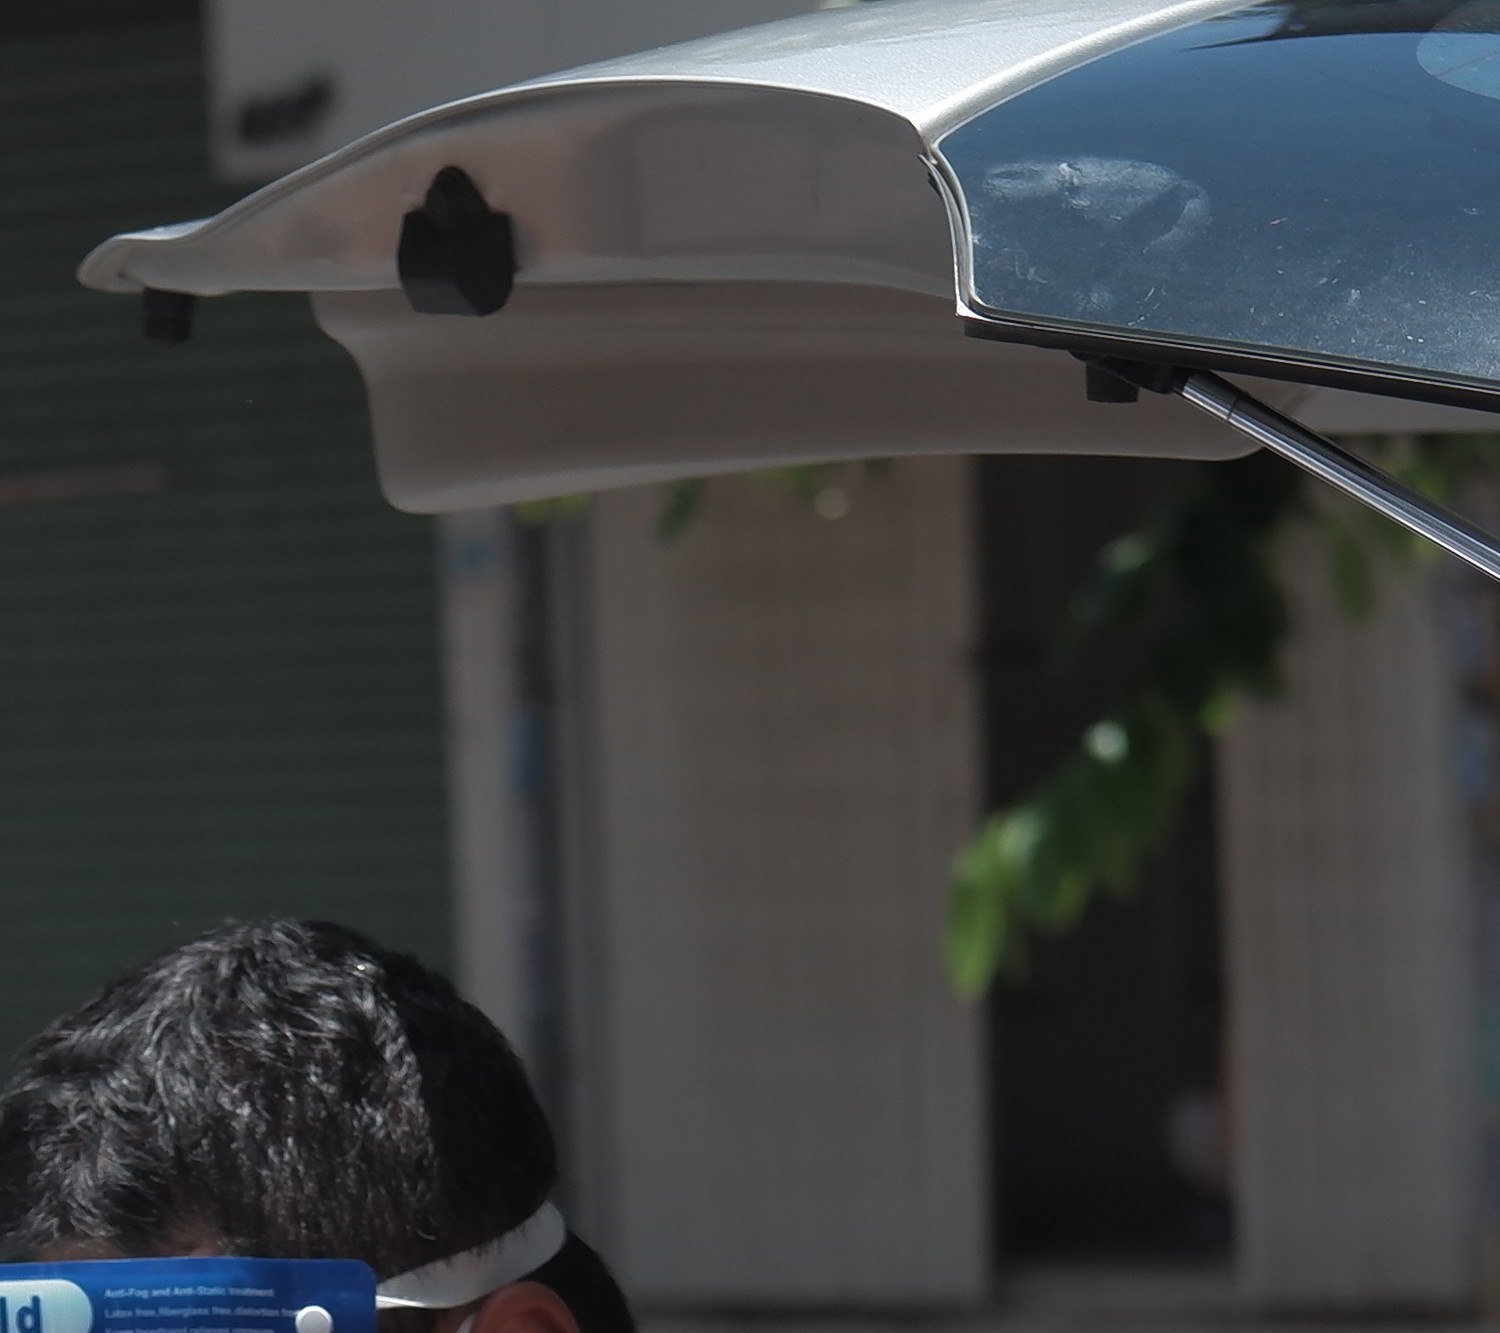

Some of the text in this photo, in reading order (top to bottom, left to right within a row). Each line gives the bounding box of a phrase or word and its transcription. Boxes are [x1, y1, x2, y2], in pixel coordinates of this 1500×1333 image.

[104, 1286, 275, 1299] Anti-Fog and Anti-Static treatment
